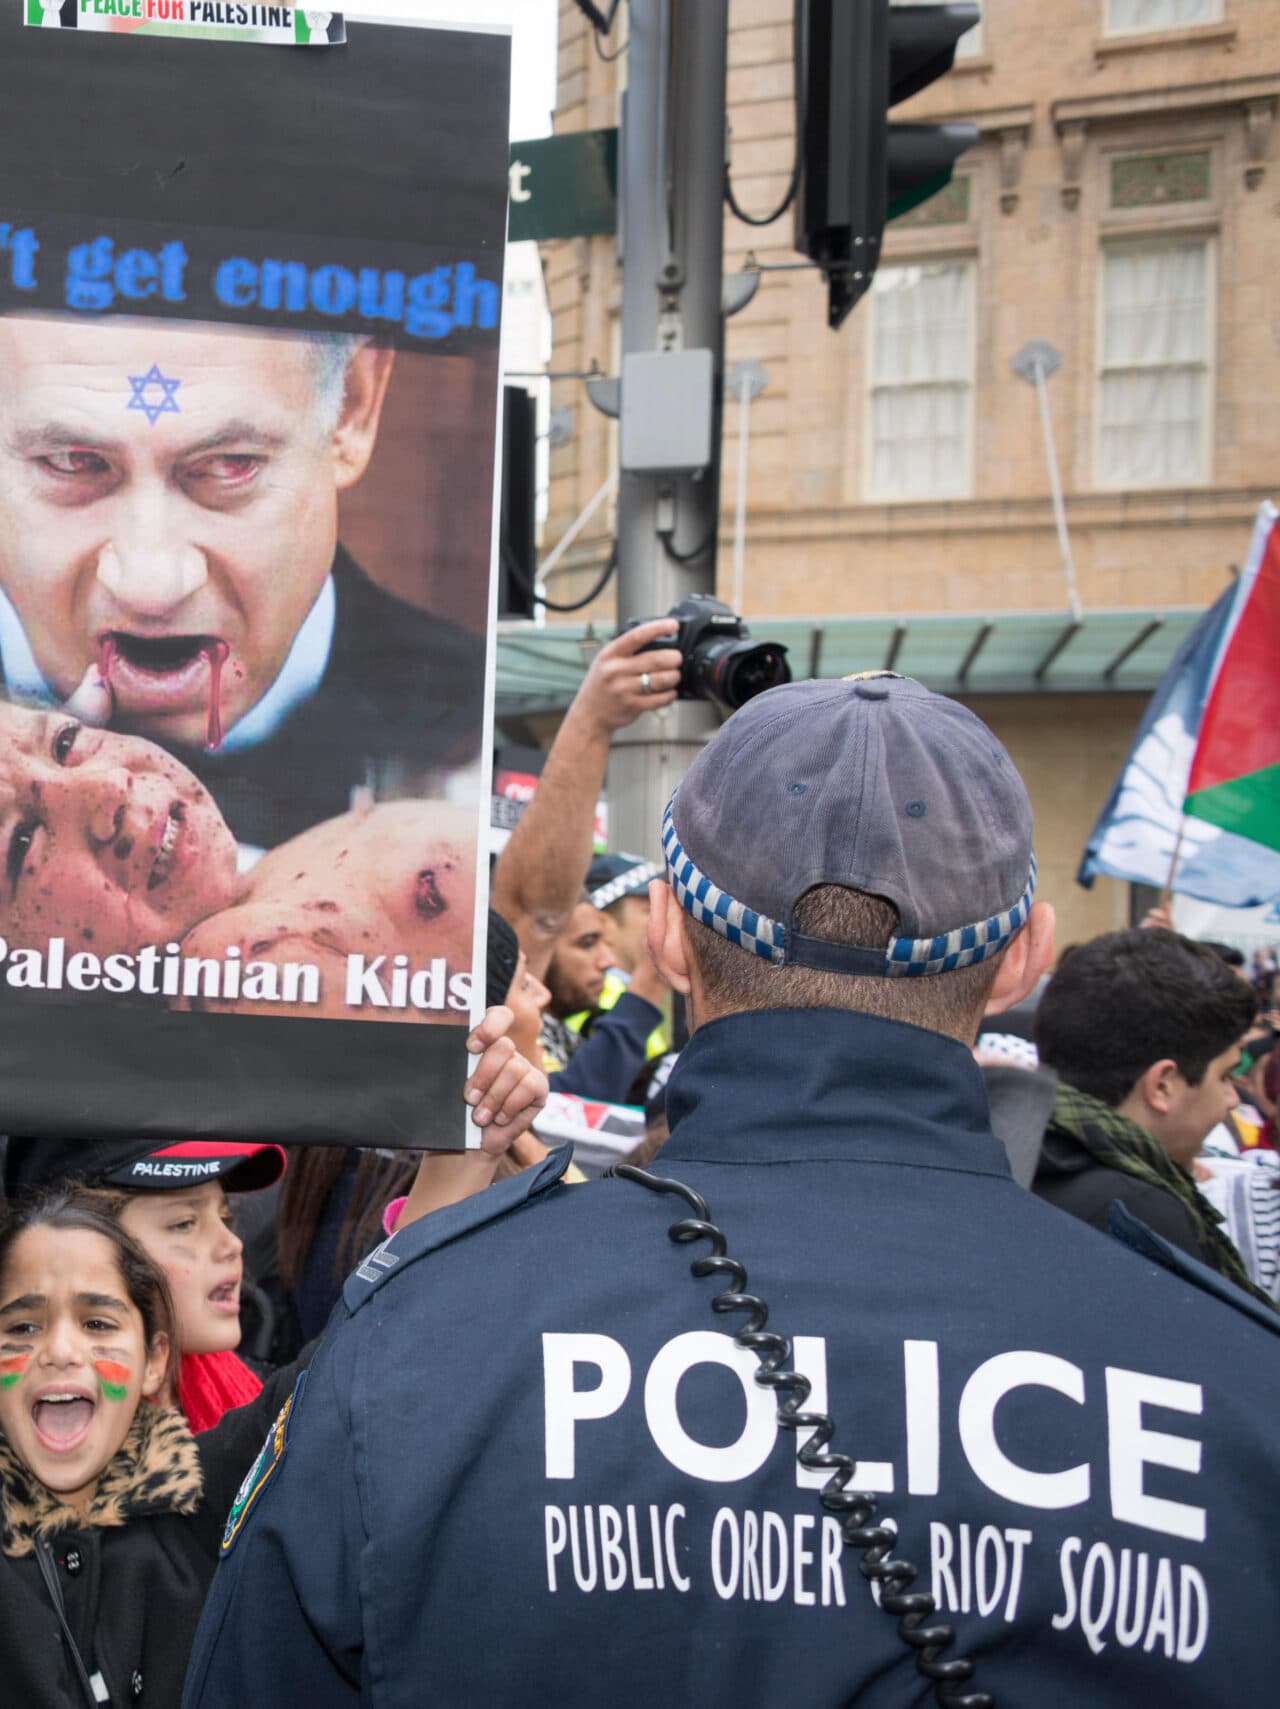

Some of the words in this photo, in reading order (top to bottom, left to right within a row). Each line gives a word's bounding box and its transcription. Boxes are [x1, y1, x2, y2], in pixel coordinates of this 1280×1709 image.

[147, 0, 184, 20] FOR
[190, 1, 292, 28] PALESTINE
[65, 235, 187, 310] get
[215, 257, 498, 338] enough
[346, 954, 473, 1011] Kids
[132, 1161, 221, 1177] PALESTINE
[542, 1330, 1207, 1542] POLICE
[545, 1503, 690, 1592] PUBLIC
[710, 1506, 847, 1607] ORDER
[929, 1521, 1032, 1622] RIOT
[1051, 1536, 1209, 1663] SQUAD
